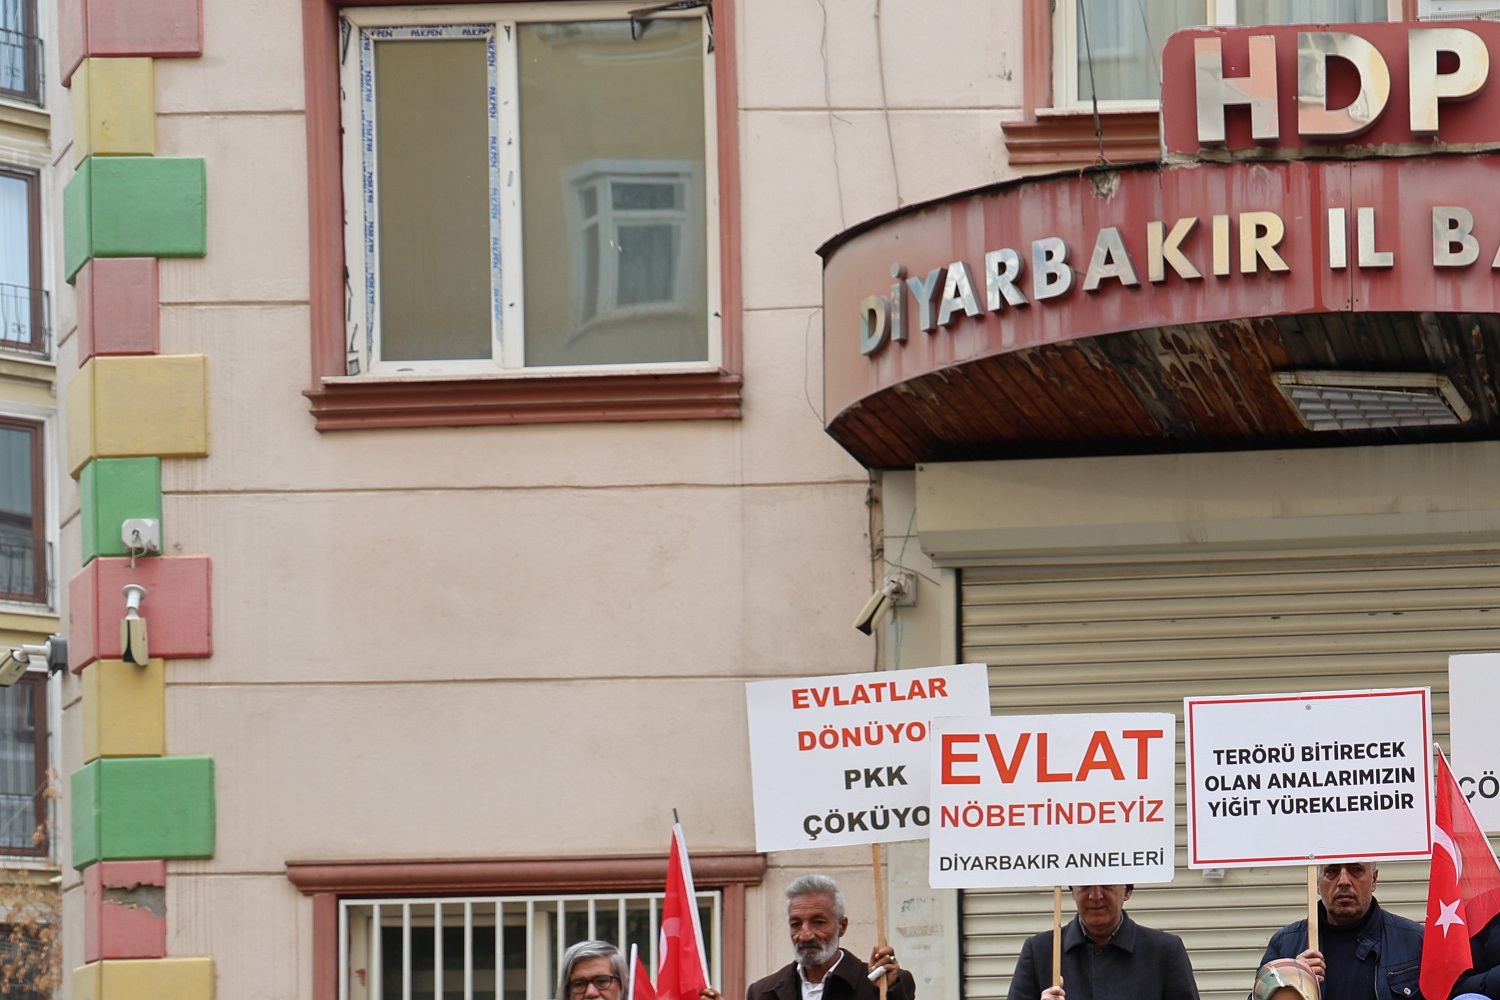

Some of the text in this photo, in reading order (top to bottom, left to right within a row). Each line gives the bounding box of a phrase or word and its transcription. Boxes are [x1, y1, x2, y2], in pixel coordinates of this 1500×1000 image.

[1193, 28, 1490, 144] HDP
[860, 210, 1290, 356] DİYARBAKIR
[791, 677, 948, 709] EVLATLAR
[798, 720, 931, 751] DÖNÜYO
[941, 729, 1164, 785] EVLAT
[1213, 740, 1406, 766] TERÖRÜ BİTİRECEK
[844, 764, 908, 790] PKK
[1204, 766, 1416, 792] OLAN ANALARIMIZIN
[940, 795, 1164, 828] NÖBETİNDEYİZ
[1207, 791, 1414, 818] YİĞİT YÜREKLERİDİR
[803, 804, 930, 841] ÇÖKÜYO
[939, 847, 1165, 872] DİYARBAKIR ANNELERİ
